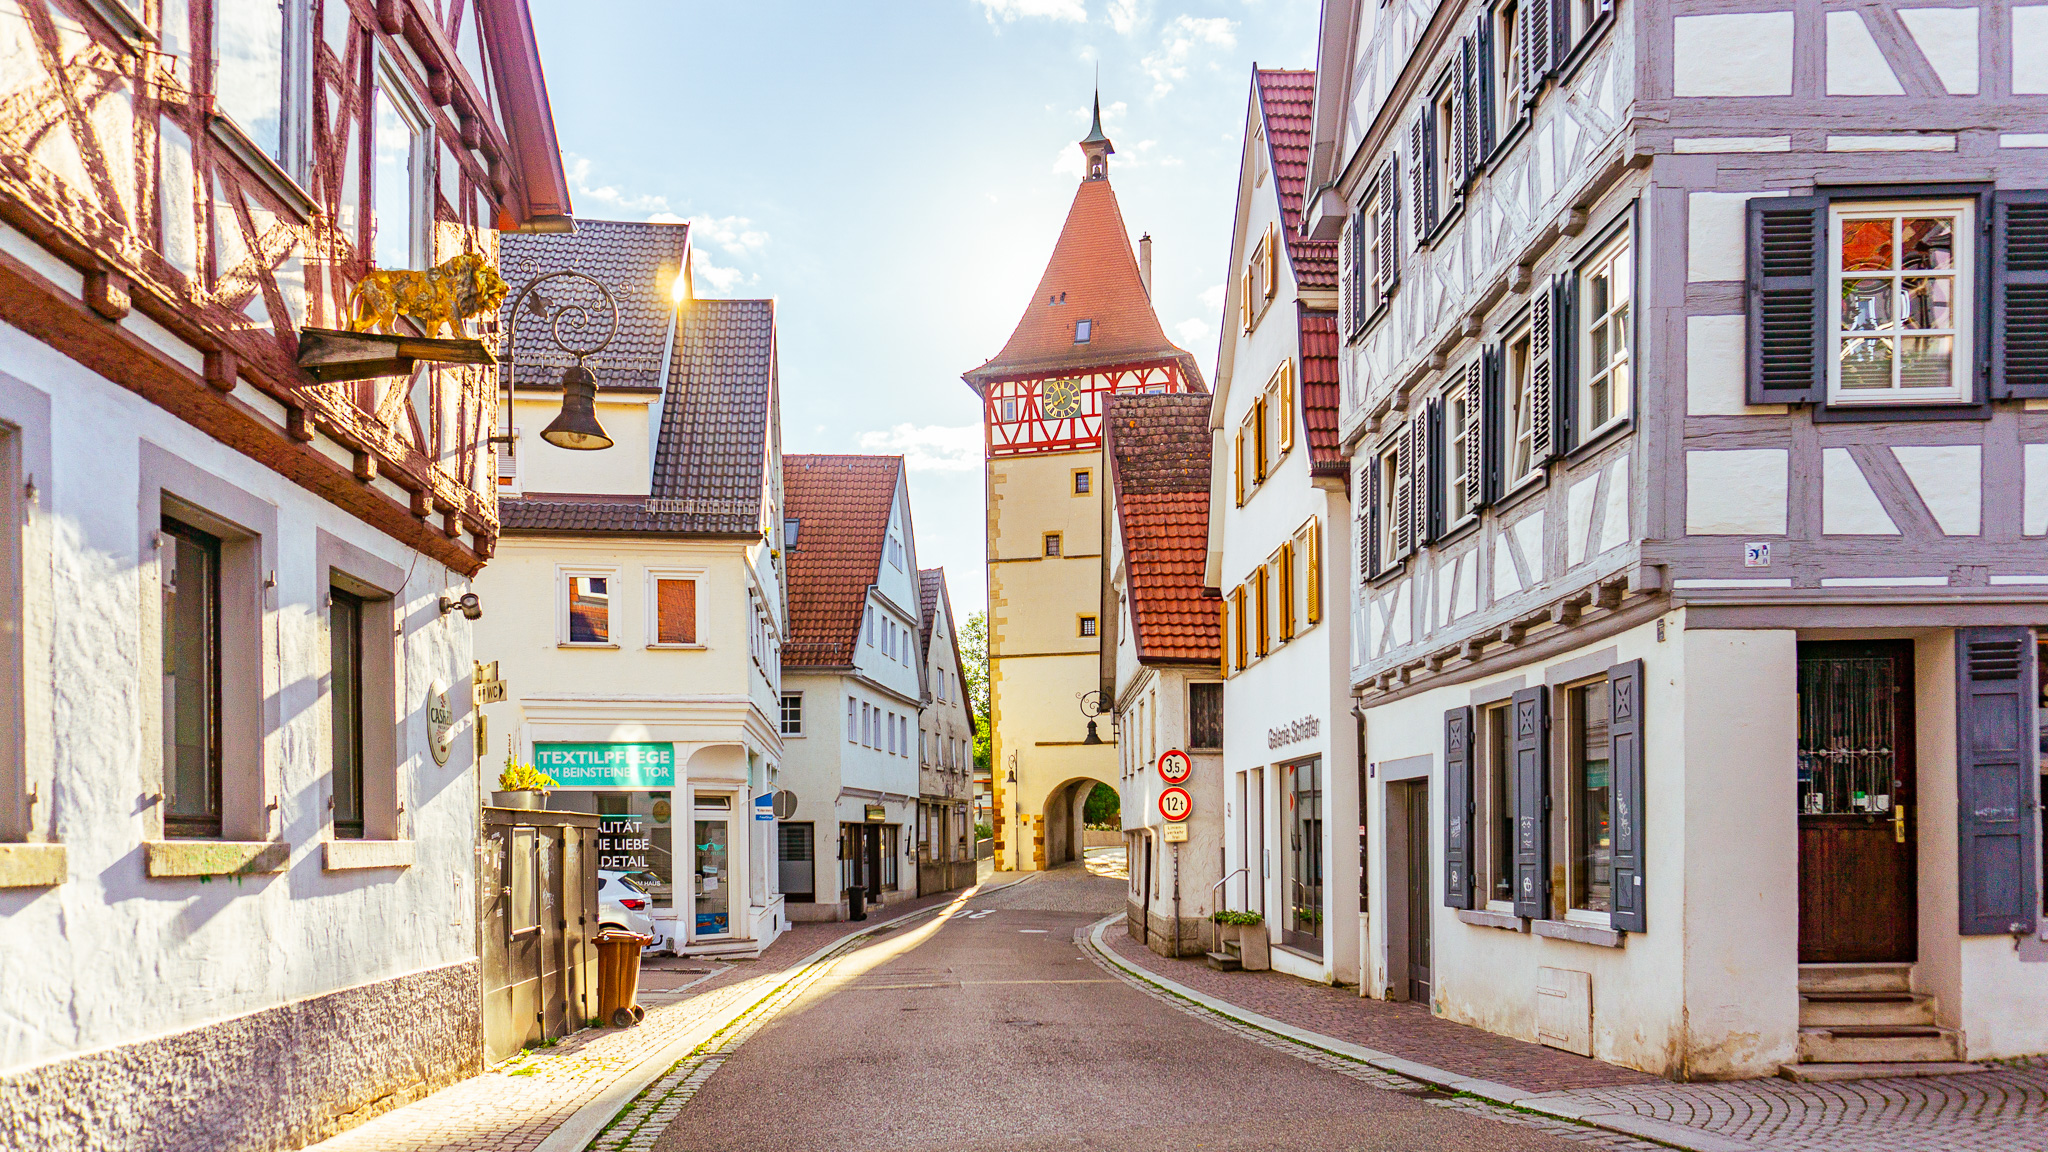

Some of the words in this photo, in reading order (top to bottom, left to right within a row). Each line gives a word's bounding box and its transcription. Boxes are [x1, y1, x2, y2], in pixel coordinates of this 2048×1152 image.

[487, 685, 498, 699] WC
[1268, 724, 1290, 750] Galerie
[1291, 714, 1320, 743] Schäfer
[540, 751, 670, 764] TEXTILPFLEGE
[541, 767, 559, 777] AM
[563, 767, 638, 777] BEINSTEINE
[643, 766, 670, 777] TOR
[1165, 758, 1180, 774] 3,5
[1166, 797, 1178, 811] 12
[1179, 800, 1184, 811] t
[614, 838, 650, 850] LIEBE
[600, 855, 650, 868] DETAIL
